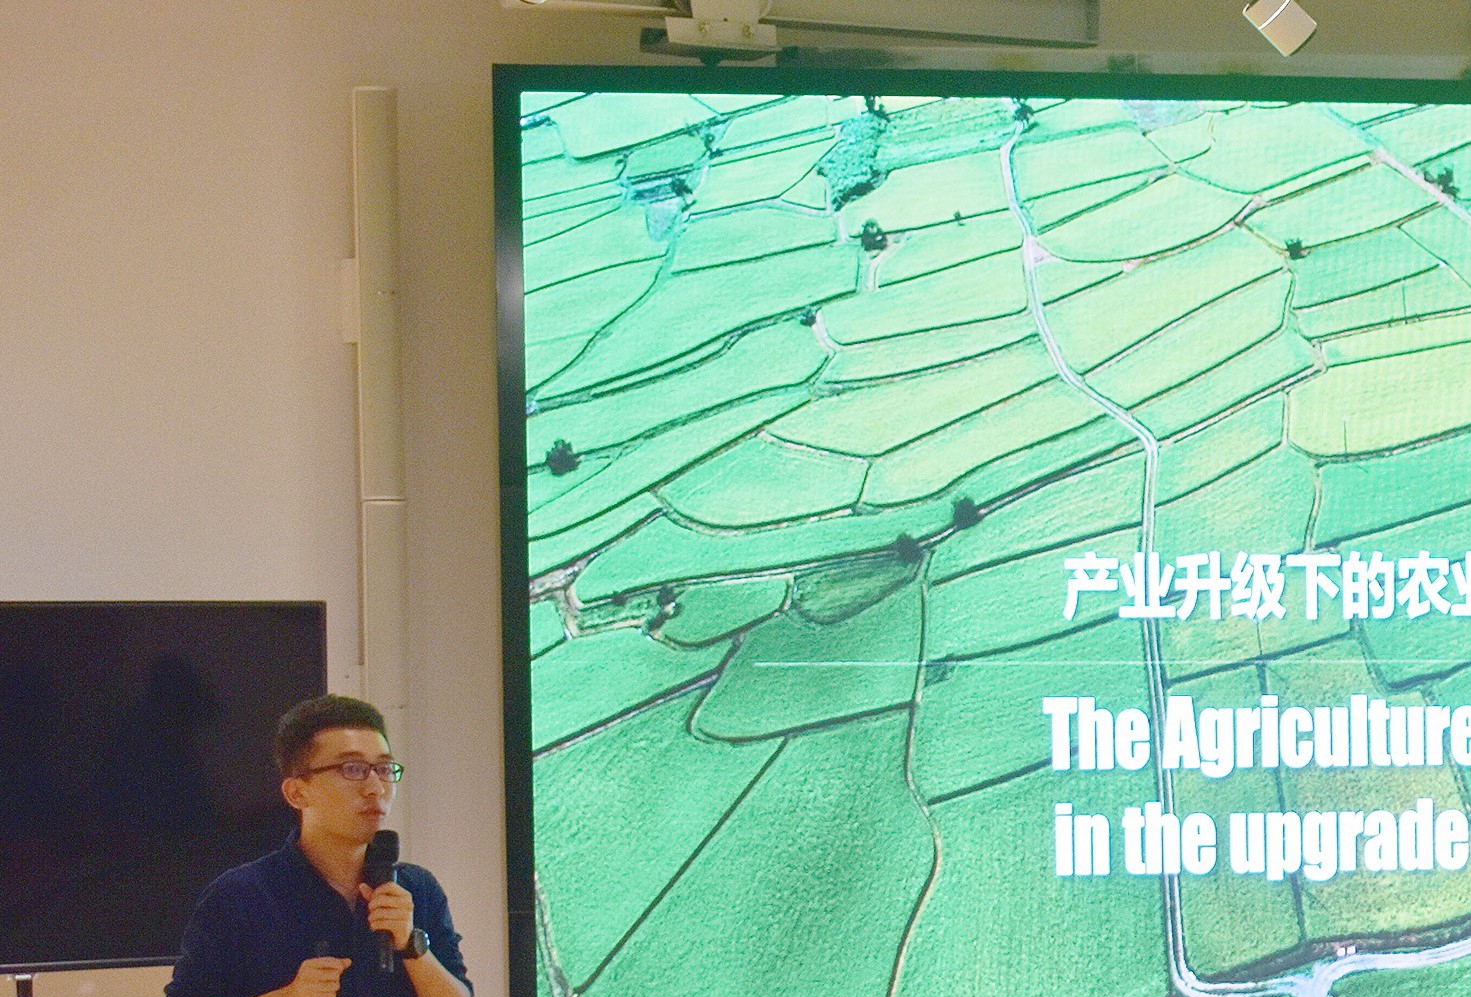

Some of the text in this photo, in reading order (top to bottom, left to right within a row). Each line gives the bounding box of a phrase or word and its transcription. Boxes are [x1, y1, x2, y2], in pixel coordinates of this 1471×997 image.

[1042, 697, 1150, 770] The
[1055, 802, 1111, 876] in
[1123, 802, 1217, 875] the
[1228, 797, 1469, 881] upgrade
